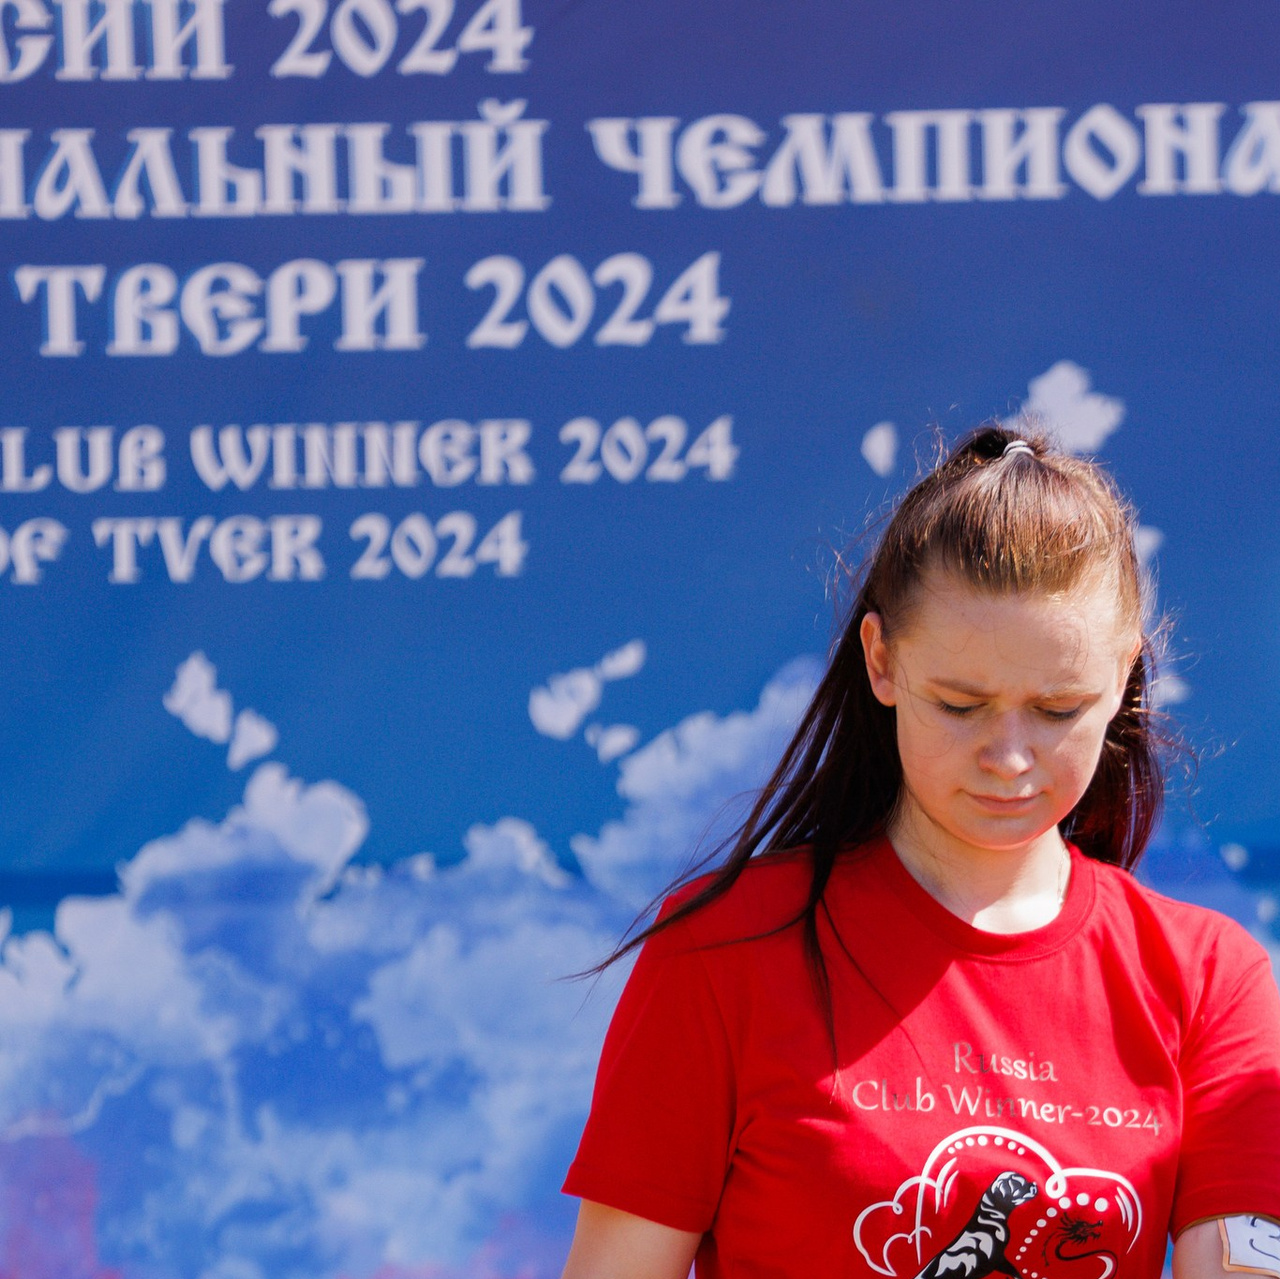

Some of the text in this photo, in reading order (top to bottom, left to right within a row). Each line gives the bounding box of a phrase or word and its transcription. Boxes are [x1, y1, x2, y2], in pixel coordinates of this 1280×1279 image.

[270, 0, 534, 78] 2024
[14, 252, 731, 357] ТВЕРИ 2024
[190, 418, 536, 492] WINNER
[558, 414, 739, 484] 2024
[91, 514, 326, 584] TVER
[349, 510, 530, 580] 2024
[953, 1042, 1058, 1082] Russia
[852, 1077, 1163, 1136] Club Winner-2024
